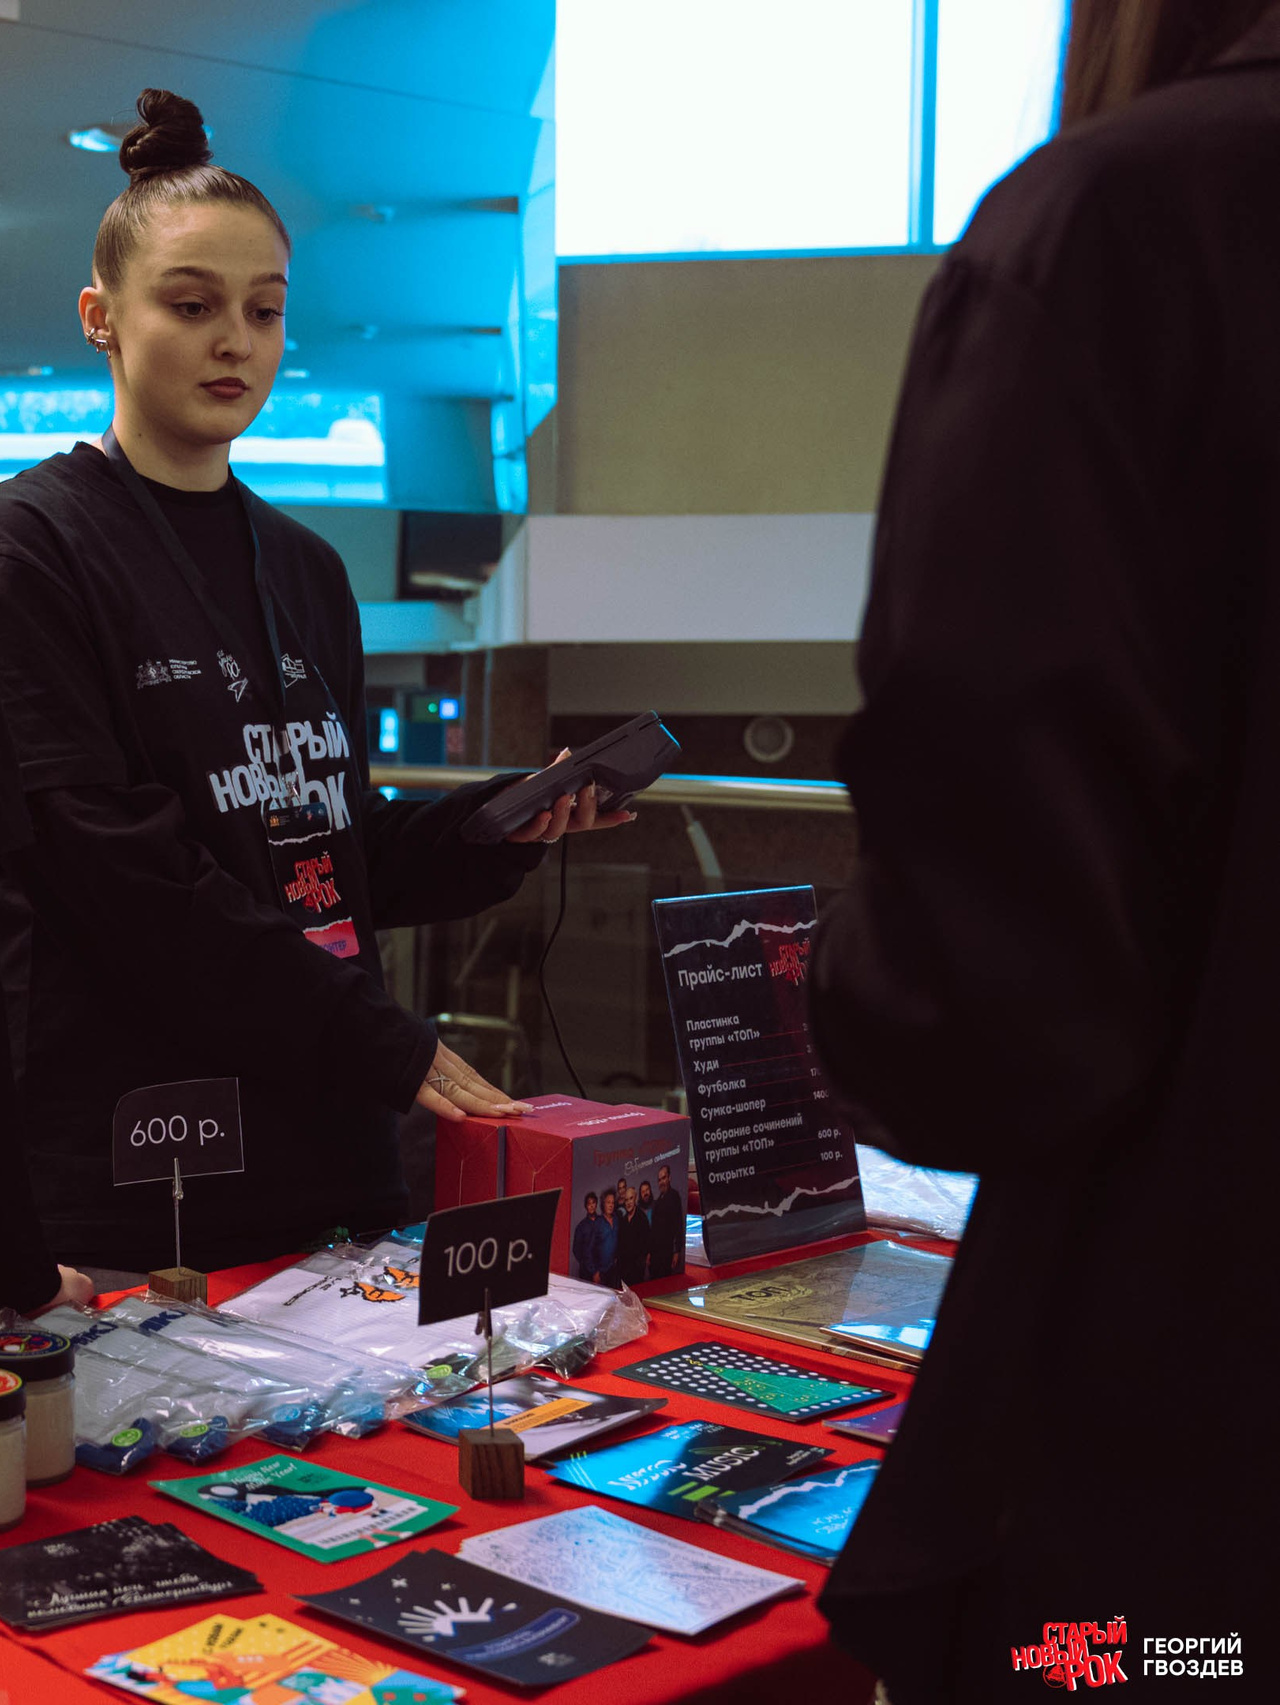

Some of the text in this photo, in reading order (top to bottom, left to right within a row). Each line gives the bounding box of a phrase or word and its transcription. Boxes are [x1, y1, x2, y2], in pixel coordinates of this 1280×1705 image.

[677, 963, 763, 991] Прайс-лист
[686, 1015, 740, 1032] Пластинка
[689, 1028, 761, 1052] группы «ТОП»
[693, 1059, 720, 1075] Худи
[697, 1078, 747, 1098] Футболка
[700, 1098, 767, 1121] Сумка-шопер
[129, 1114, 226, 1147] 600 р.
[703, 1113, 803, 1144] Собрание сочинений
[705, 1128, 842, 1163] группы «ТОП» 600 р.
[708, 1150, 843, 1185] Открытка 100 р.
[444, 1237, 533, 1277] 100 р.
[681, 1446, 761, 1482] MUSIC
